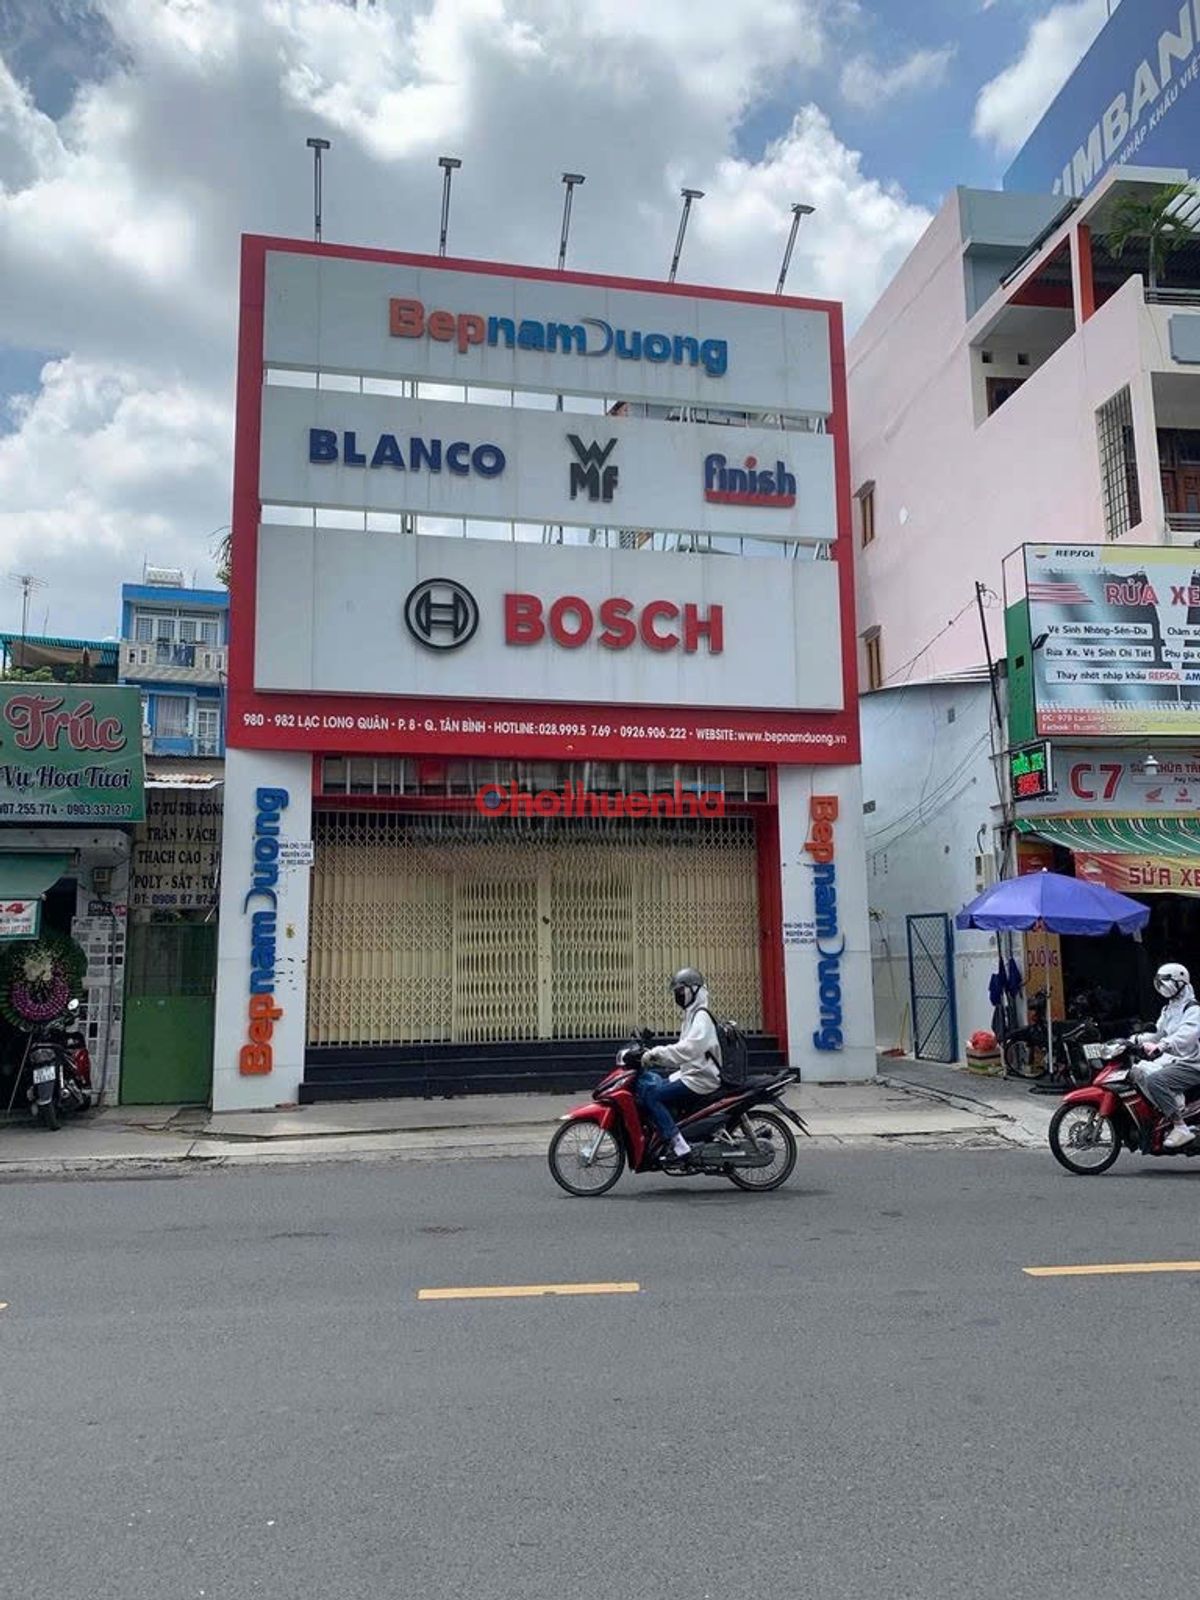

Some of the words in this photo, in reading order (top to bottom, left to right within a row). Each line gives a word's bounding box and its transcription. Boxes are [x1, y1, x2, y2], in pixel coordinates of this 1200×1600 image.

[309, 427, 506, 480] BLANCO
[566, 433, 619, 503] WMF
[704, 453, 797, 496] finish
[1055, 549, 1096, 558] REPSOL
[1104, 577, 1159, 606] RỬA
[504, 592, 724, 655] BOSCH
[4, 693, 127, 751] Trúc
[243, 713, 264, 727] 980
[274, 714, 295, 728] 982
[298, 715, 320, 731] LẠC
[323, 716, 354, 728] LONG
[357, 714, 389, 730] QUÂN
[440, 716, 460, 732] TÂN
[462, 716, 486, 733] BÌNH
[620, 725, 687, 738] 0926.906.222
[35, 765, 80, 789] Hoa
[1070, 762, 1124, 801] C7
[178, 850, 202, 864] CAO
[134, 875, 164, 889] POLY
[1128, 861, 1171, 887] SỬA
